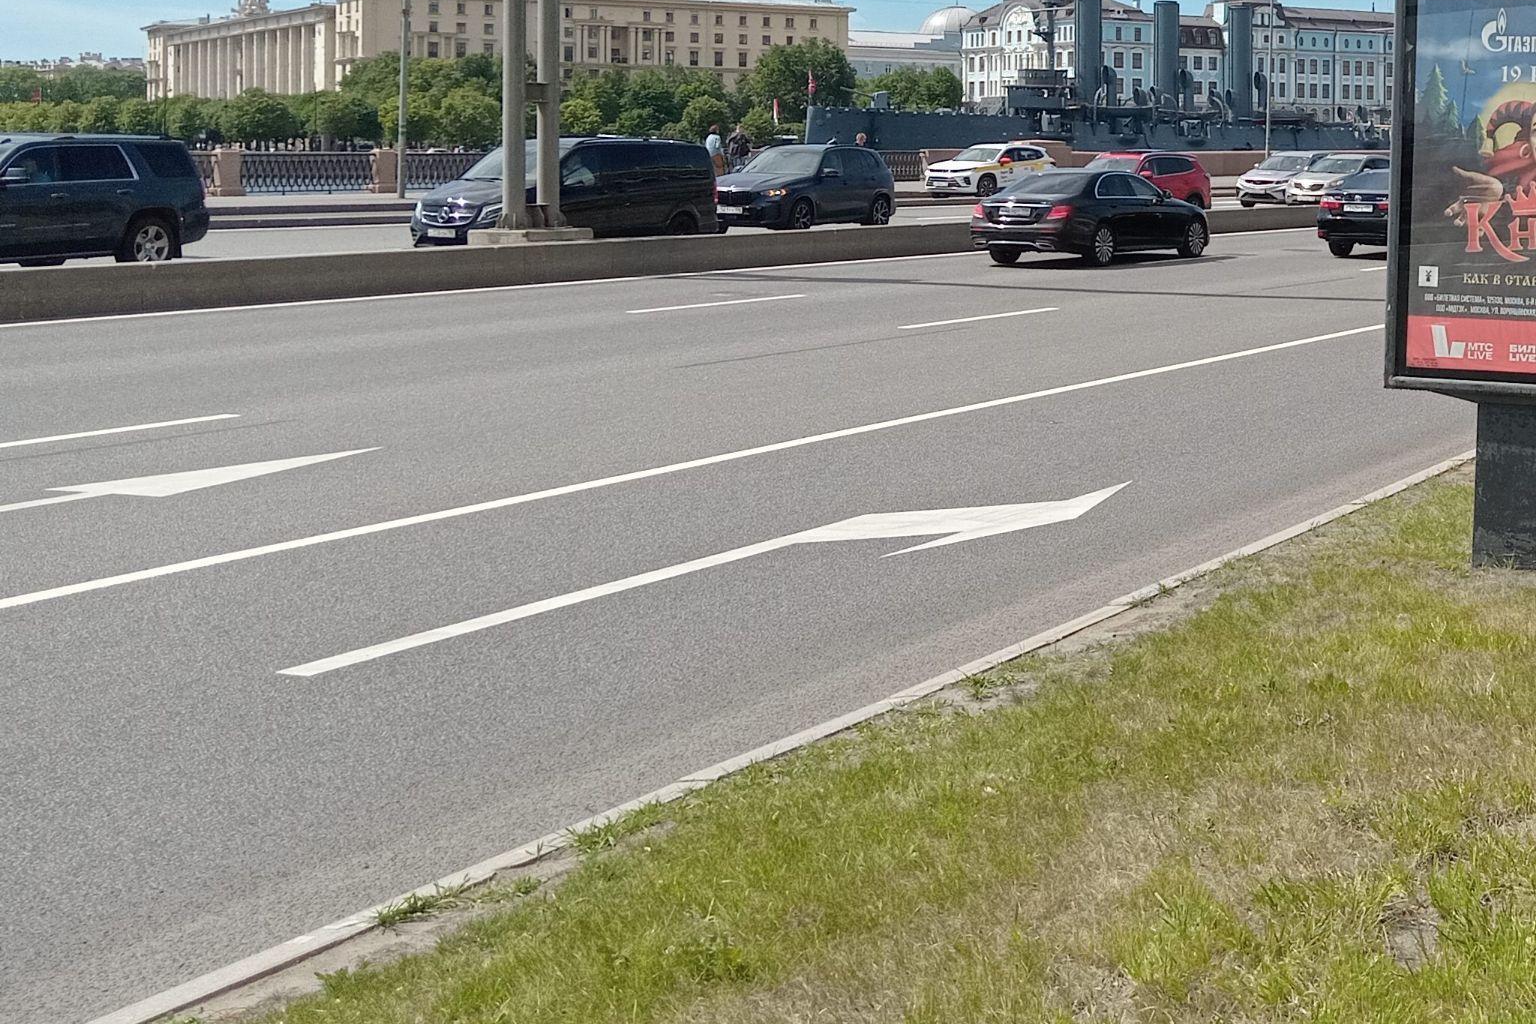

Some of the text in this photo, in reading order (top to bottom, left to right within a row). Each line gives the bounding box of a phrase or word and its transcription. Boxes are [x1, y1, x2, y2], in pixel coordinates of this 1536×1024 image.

[1501, 65, 1522, 83] 19
[1463, 273, 1489, 285] КАК
[1493, 274, 1501, 285] В
[1467, 342, 1494, 352] МТС
[1467, 351, 1493, 360] LIVE
